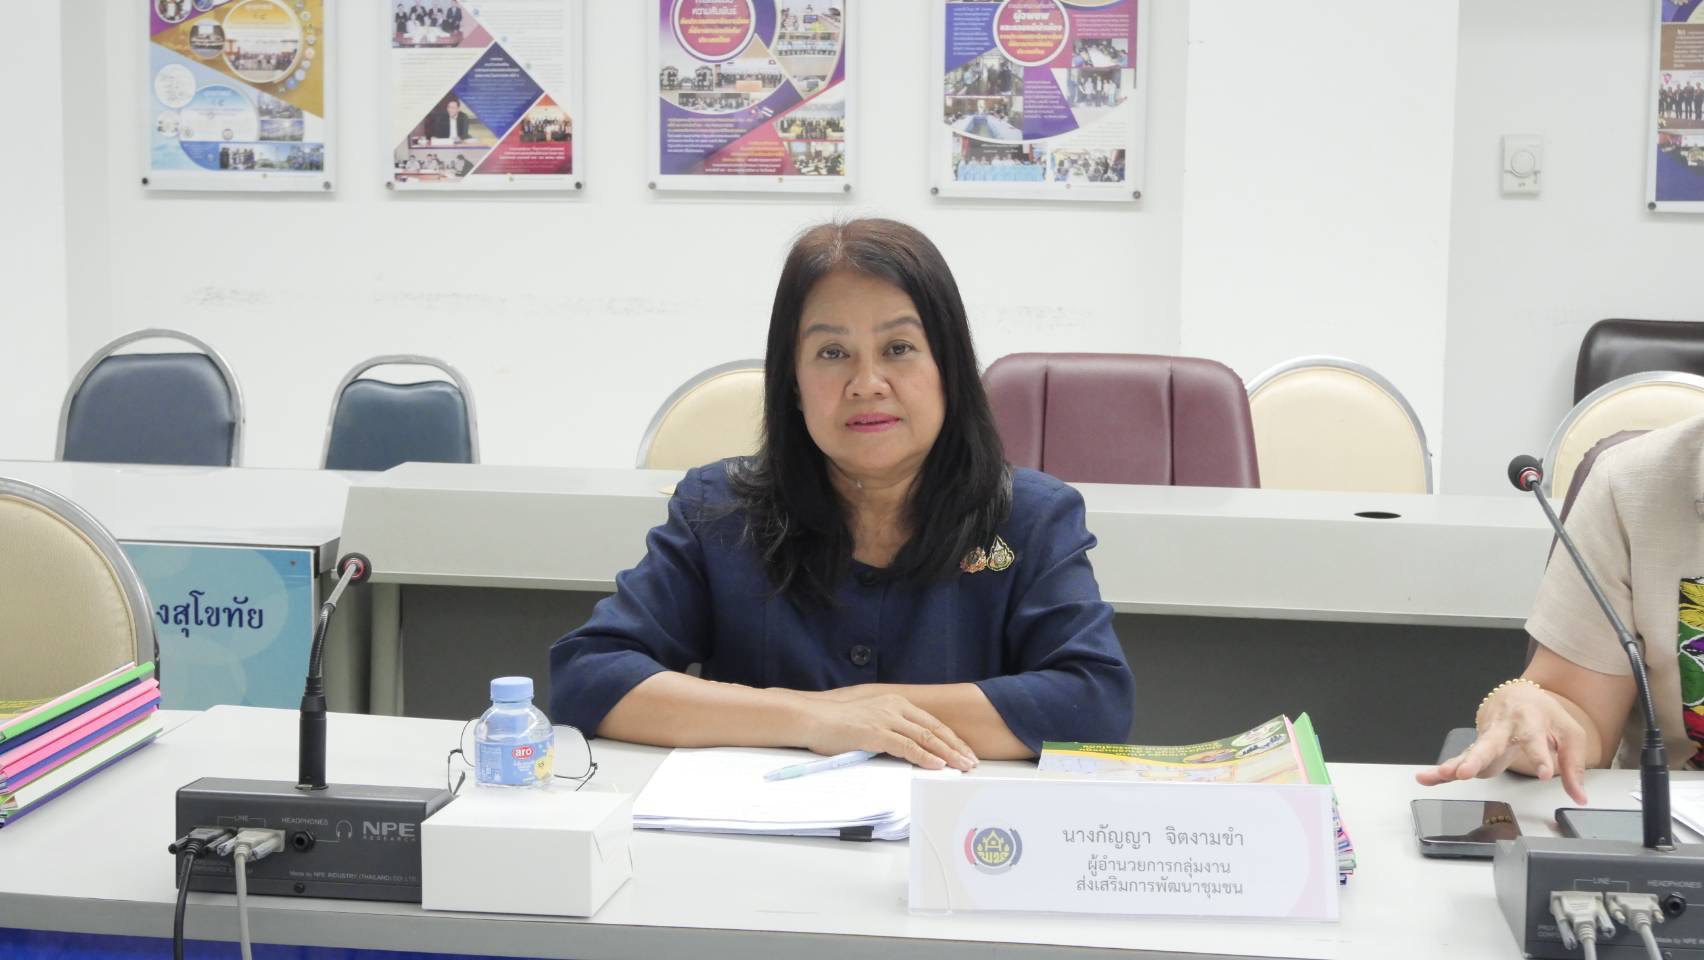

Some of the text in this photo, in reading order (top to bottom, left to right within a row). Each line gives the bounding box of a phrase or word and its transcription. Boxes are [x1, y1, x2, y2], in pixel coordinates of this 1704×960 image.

[155, 590, 264, 638] งสุโขทัย
[515, 748, 533, 757] aro
[281, 817, 329, 826] HEADPHONES
[362, 820, 416, 838] NPE
[1062, 823, 1152, 850] นางกัญญา
[1087, 854, 1232, 878] ผู้อำนวยการกลุ่มงาน
[1075, 875, 1244, 900] ส่งเสริมการพัฒนาชุมชน
[1592, 877, 1611, 885] LINE
[1647, 879, 1702, 889] HEADPHONES
